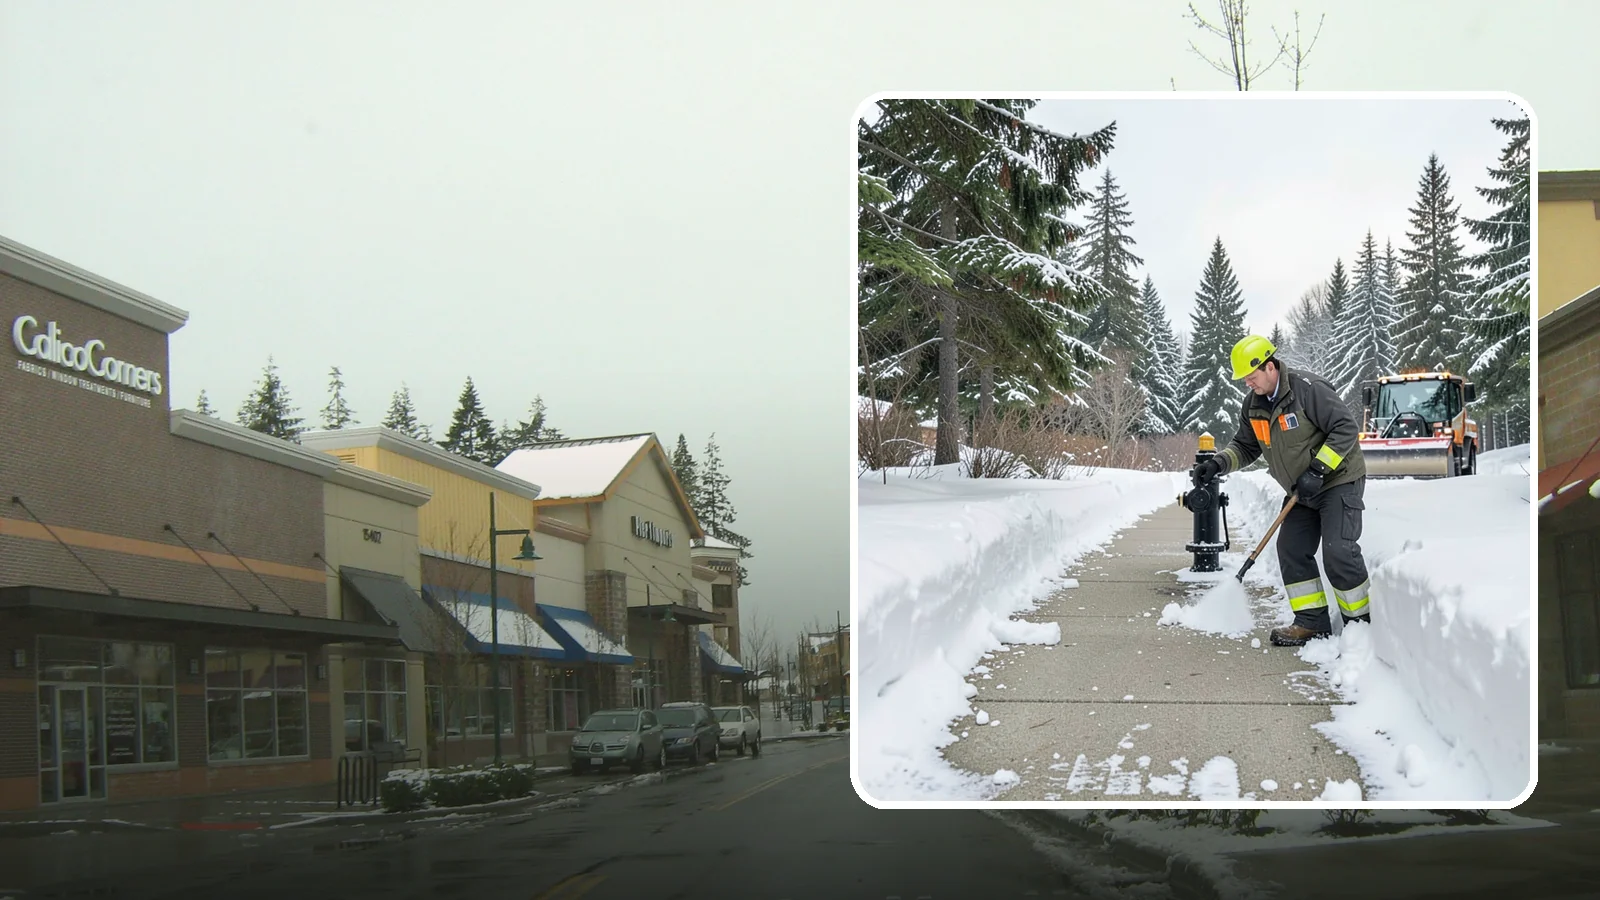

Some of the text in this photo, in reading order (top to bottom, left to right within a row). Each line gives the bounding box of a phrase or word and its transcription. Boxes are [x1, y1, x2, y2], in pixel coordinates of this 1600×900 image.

[17, 360, 151, 408] FABRICS WINDOW TREATMENTS FURNITURE
